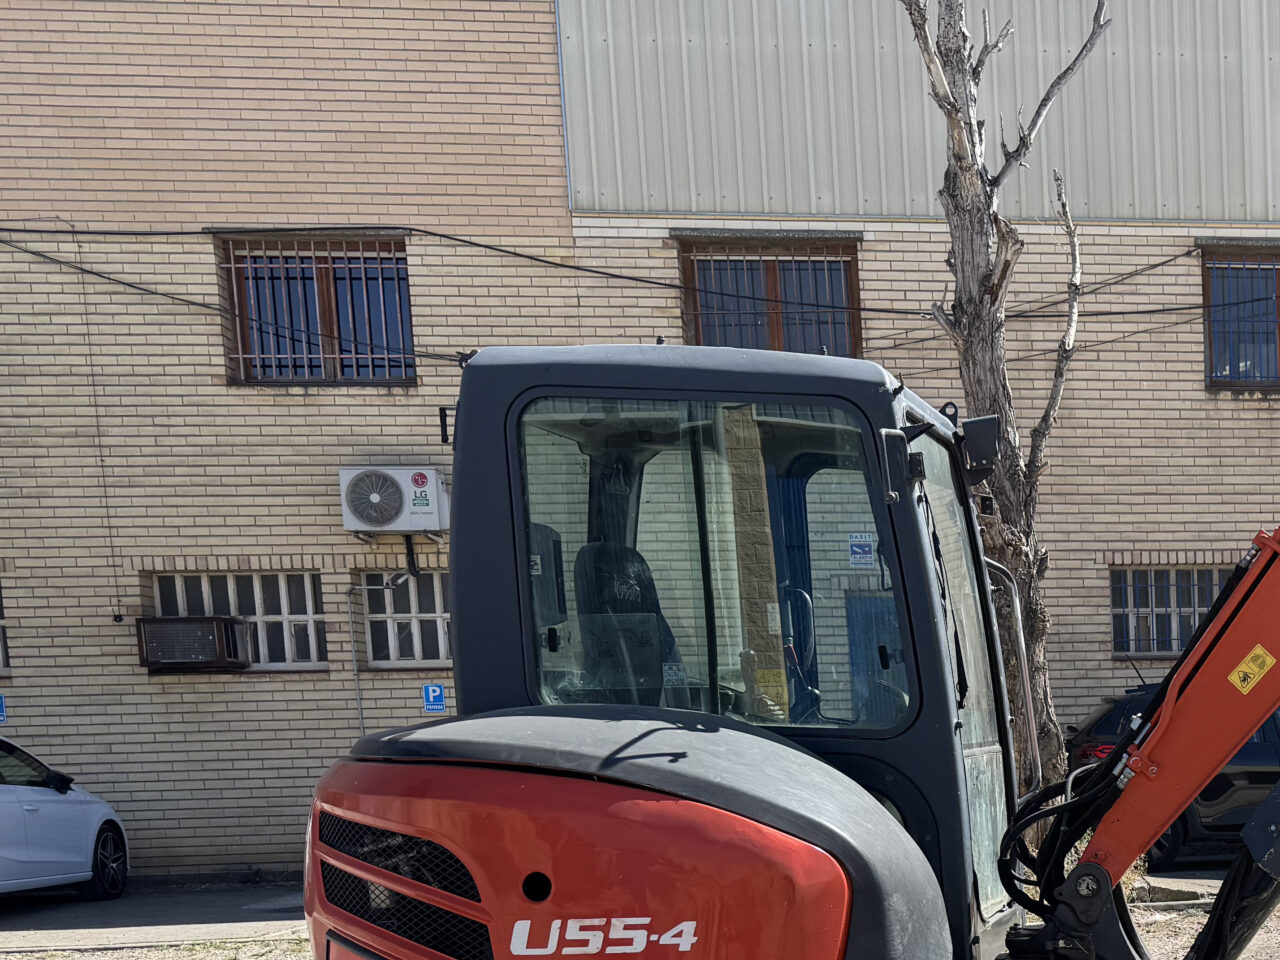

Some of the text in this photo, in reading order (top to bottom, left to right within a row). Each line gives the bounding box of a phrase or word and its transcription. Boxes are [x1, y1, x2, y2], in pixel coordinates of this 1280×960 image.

[414, 490, 428, 499] LG
[428, 686, 441, 702] P
[510, 917, 698, 956] U55-4
